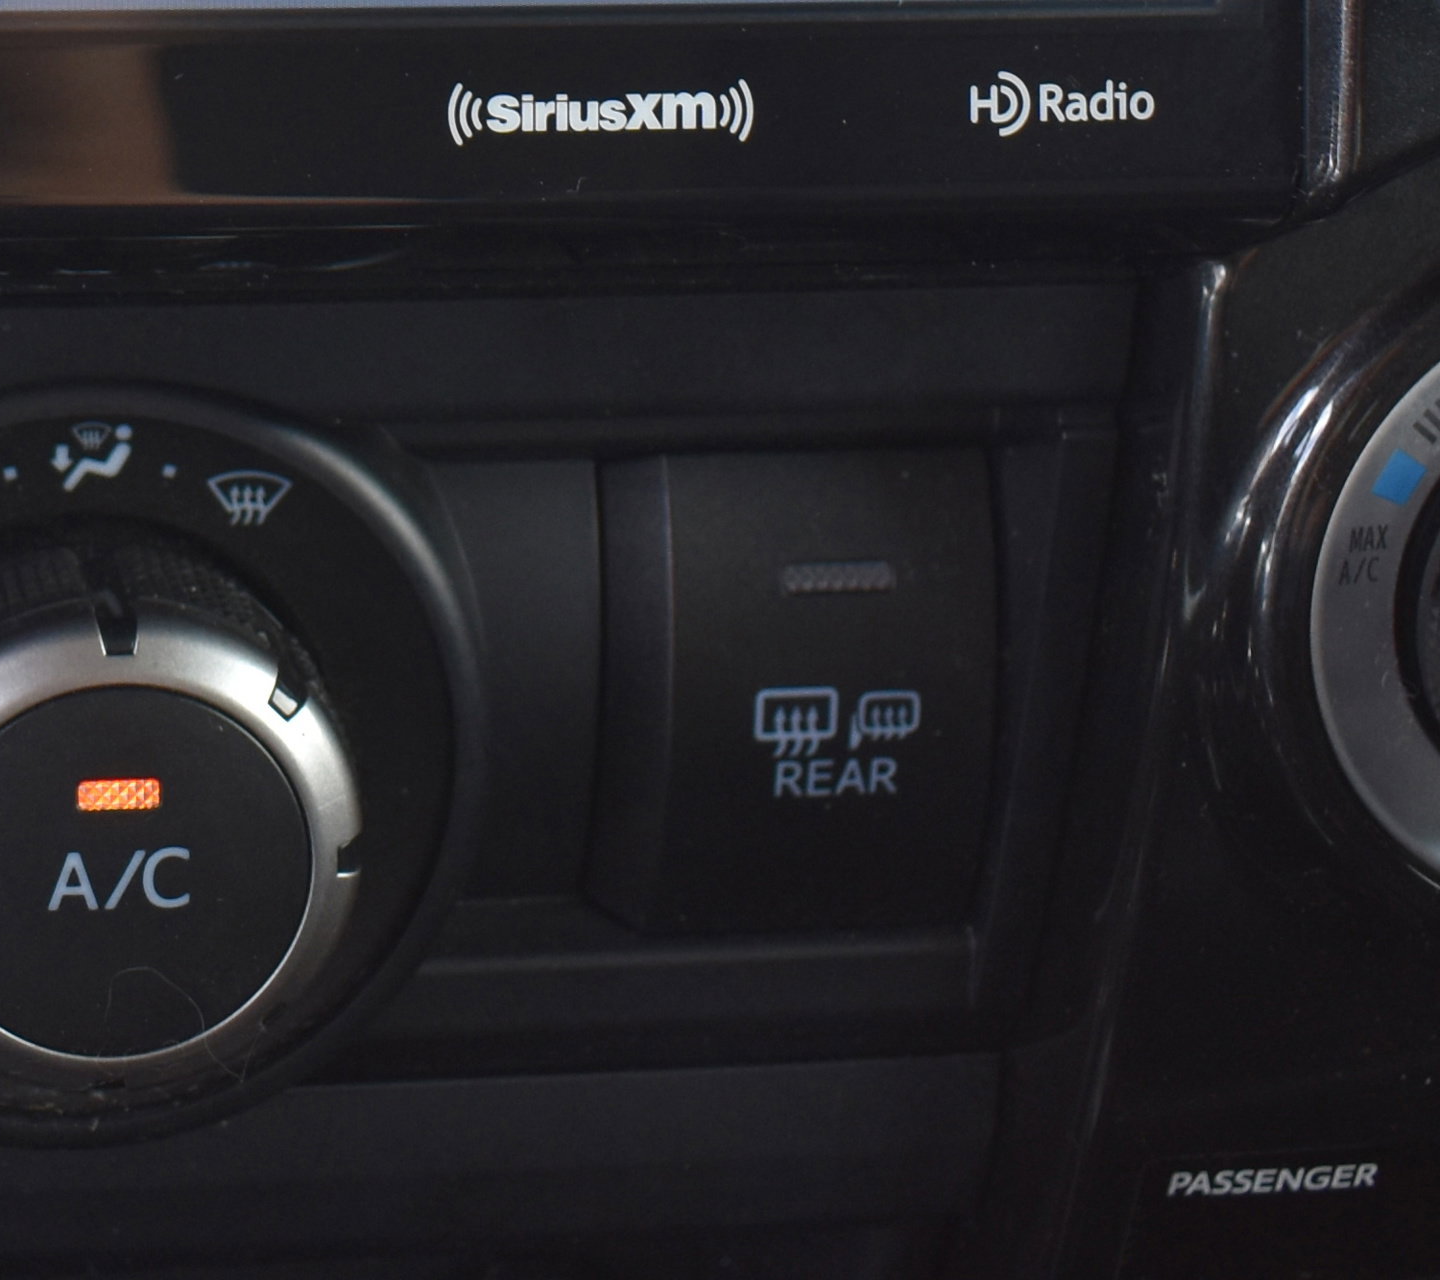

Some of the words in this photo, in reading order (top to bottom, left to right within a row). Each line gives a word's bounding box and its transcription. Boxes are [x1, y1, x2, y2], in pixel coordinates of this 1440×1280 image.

[1038, 78, 1156, 122] Radio
[1348, 524, 1389, 553] MAX
[1338, 556, 1381, 586] A/C
[773, 756, 898, 797] REAR
[47, 846, 191, 912] A/C
[1166, 1162, 1379, 1198] PASSENGER
